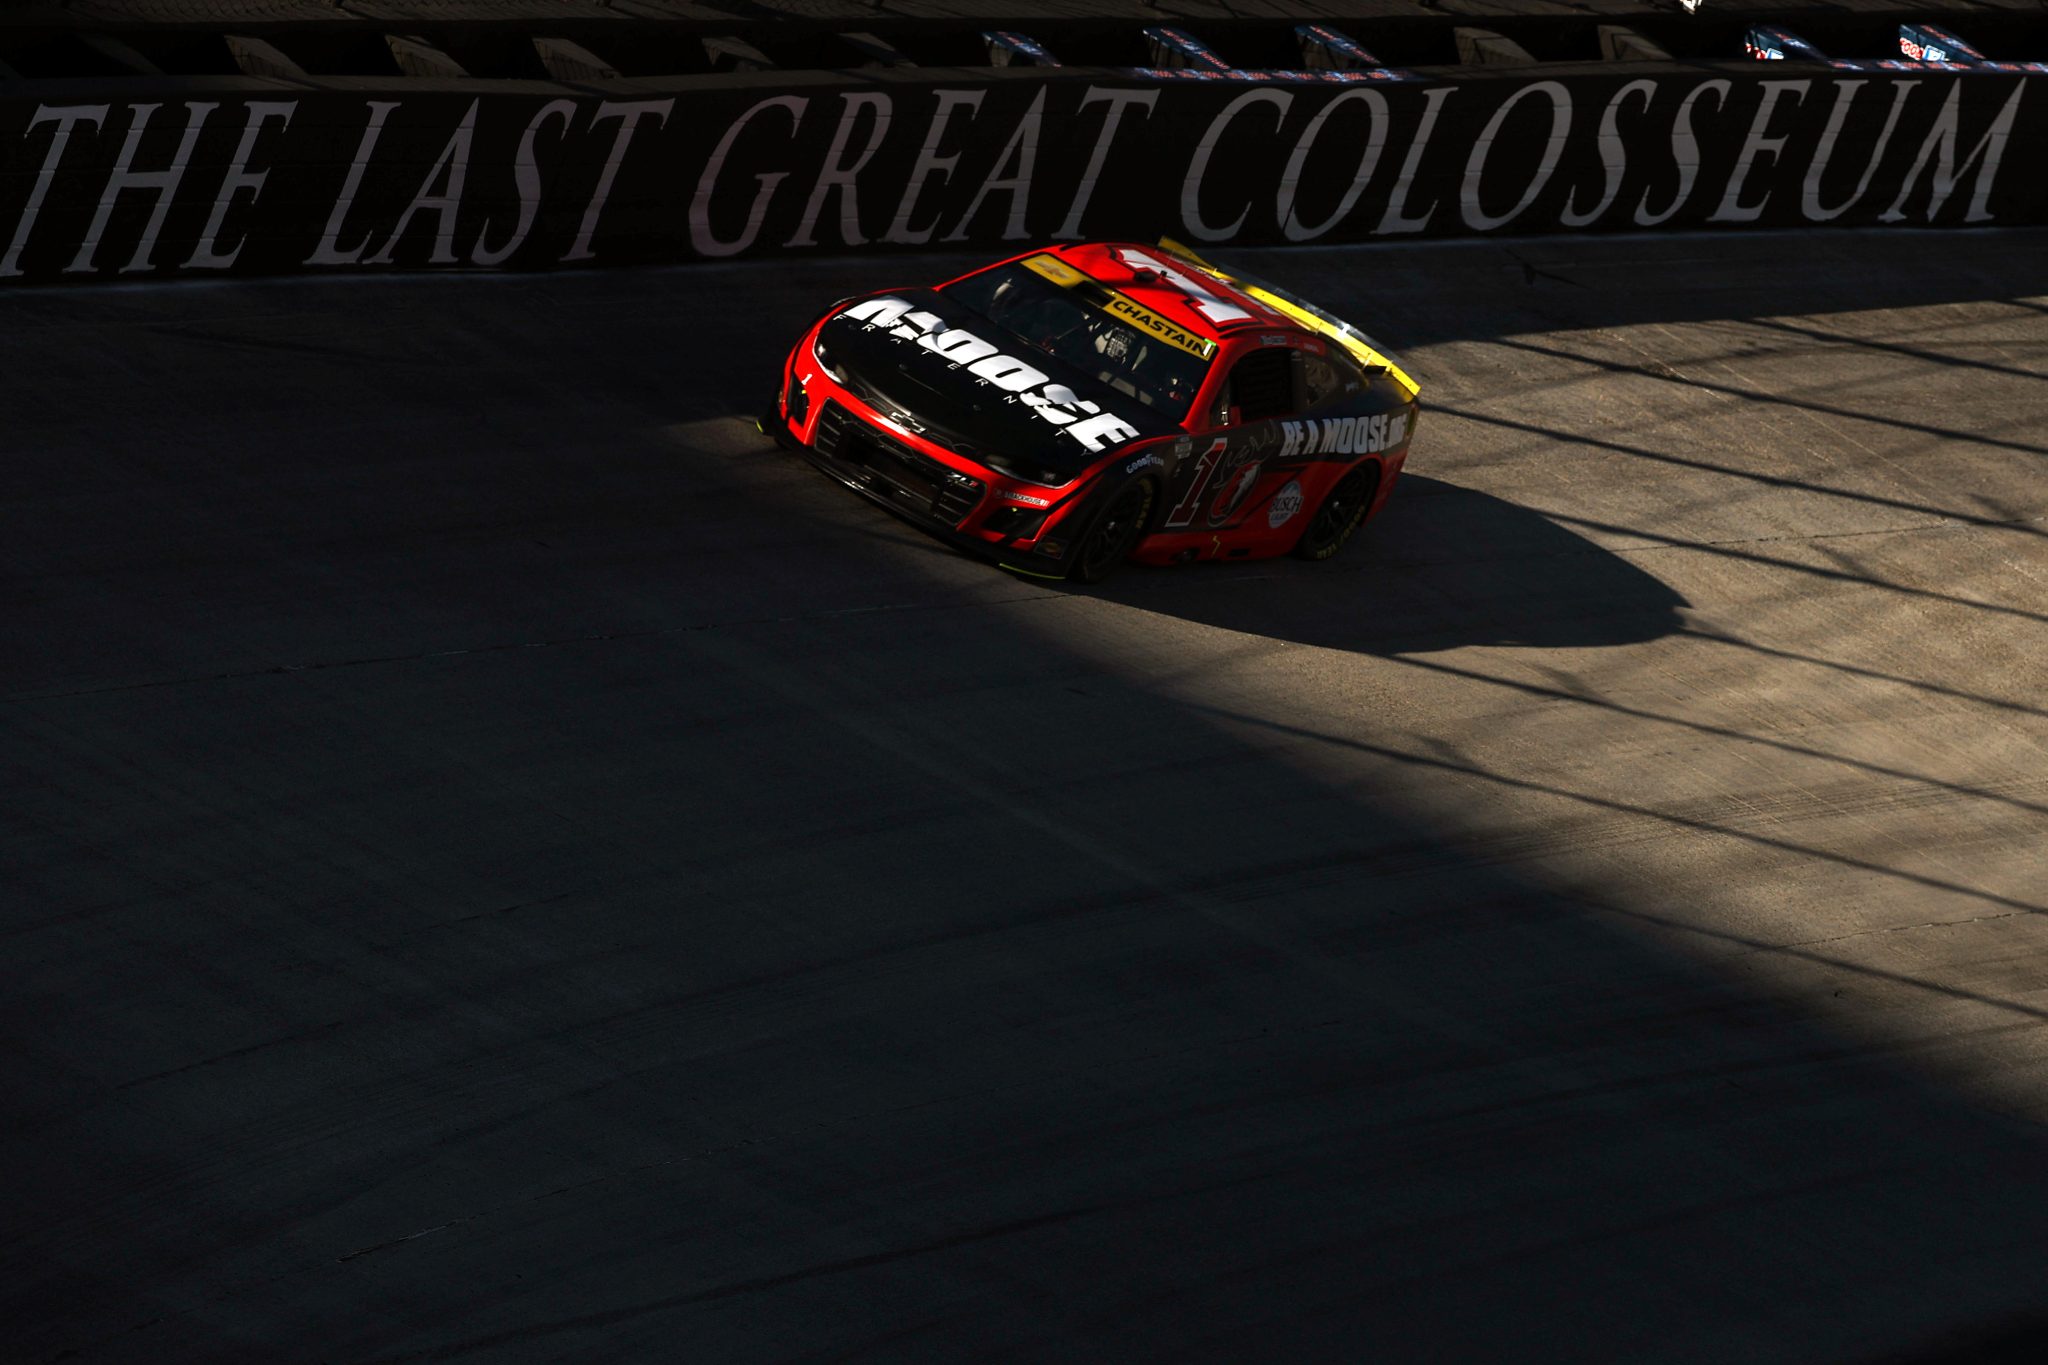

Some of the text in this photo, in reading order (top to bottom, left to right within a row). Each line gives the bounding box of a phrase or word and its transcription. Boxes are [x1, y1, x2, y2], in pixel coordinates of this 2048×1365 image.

[0, 76, 2029, 278] THE LAST GREAT COLOSSEUM
[1118, 248, 1253, 324] 1
[1112, 298, 1207, 357] CHASTAIN
[844, 295, 1141, 454] MOOSE
[1125, 453, 1165, 474] GOODYEAR
[1279, 421, 1305, 457] BE
[1301, 419, 1320, 456] A
[1164, 437, 1229, 528] 1
[1269, 496, 1304, 512] BUSCH
